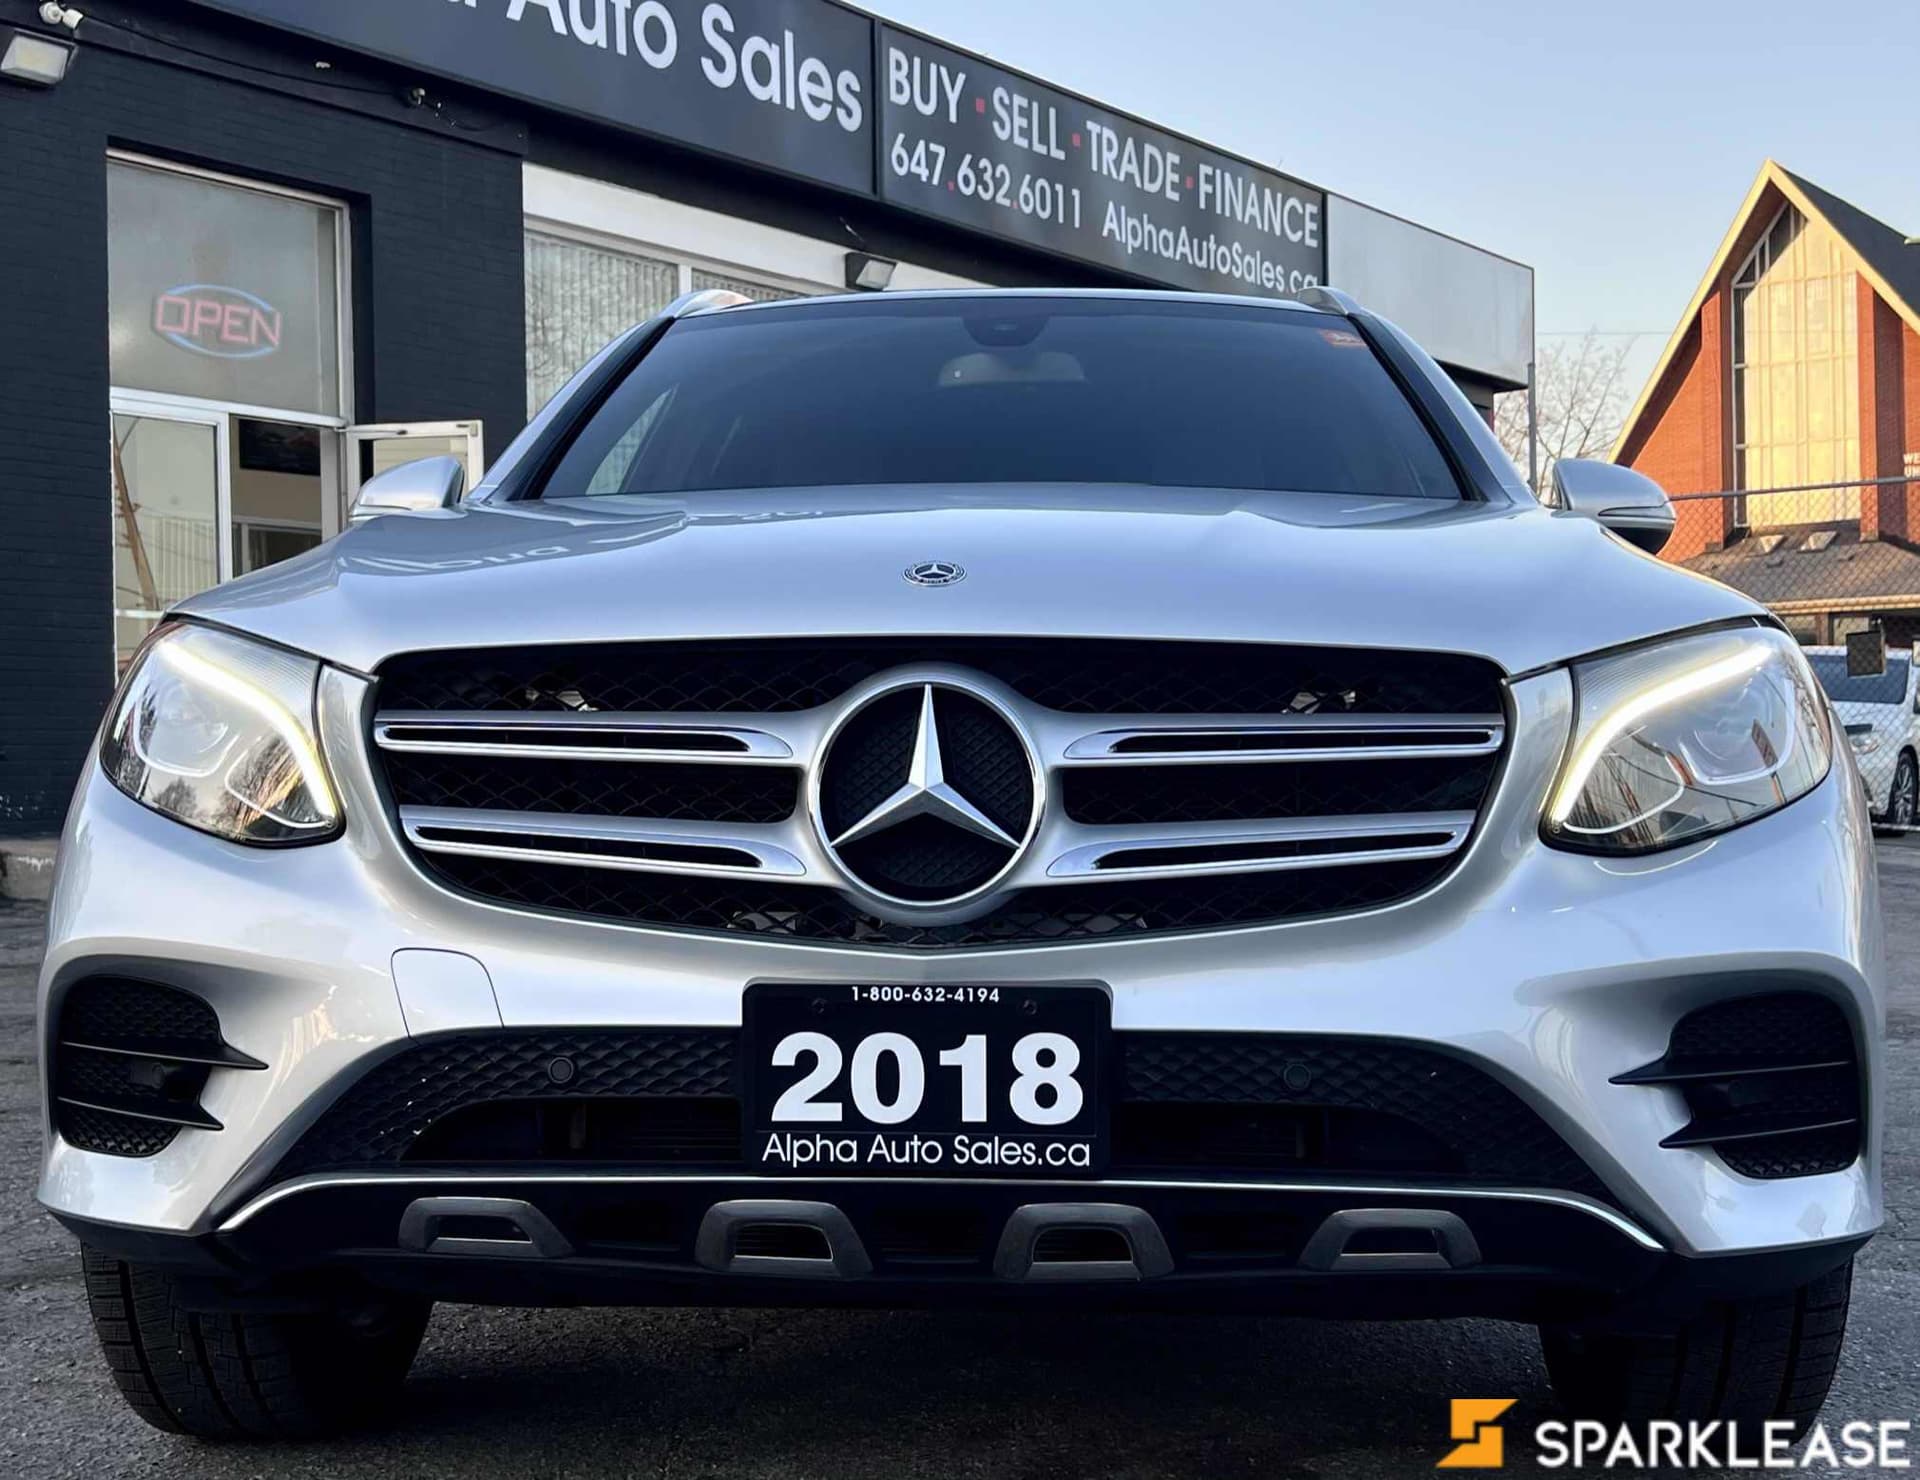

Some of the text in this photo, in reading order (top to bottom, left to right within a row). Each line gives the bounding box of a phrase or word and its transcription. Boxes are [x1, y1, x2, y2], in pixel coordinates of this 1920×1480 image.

[701, 3, 863, 132] Sales
[888, 47, 1319, 248] BUY SELL TRADE FINANCE
[891, 133, 1081, 228] 647.632.6011
[156, 294, 282, 347] OPEN
[851, 985, 1000, 1003] 1-800-632-4194
[771, 1031, 1084, 1126] 2018
[762, 1133, 1090, 1168] Alpha Auto Sales.ca
